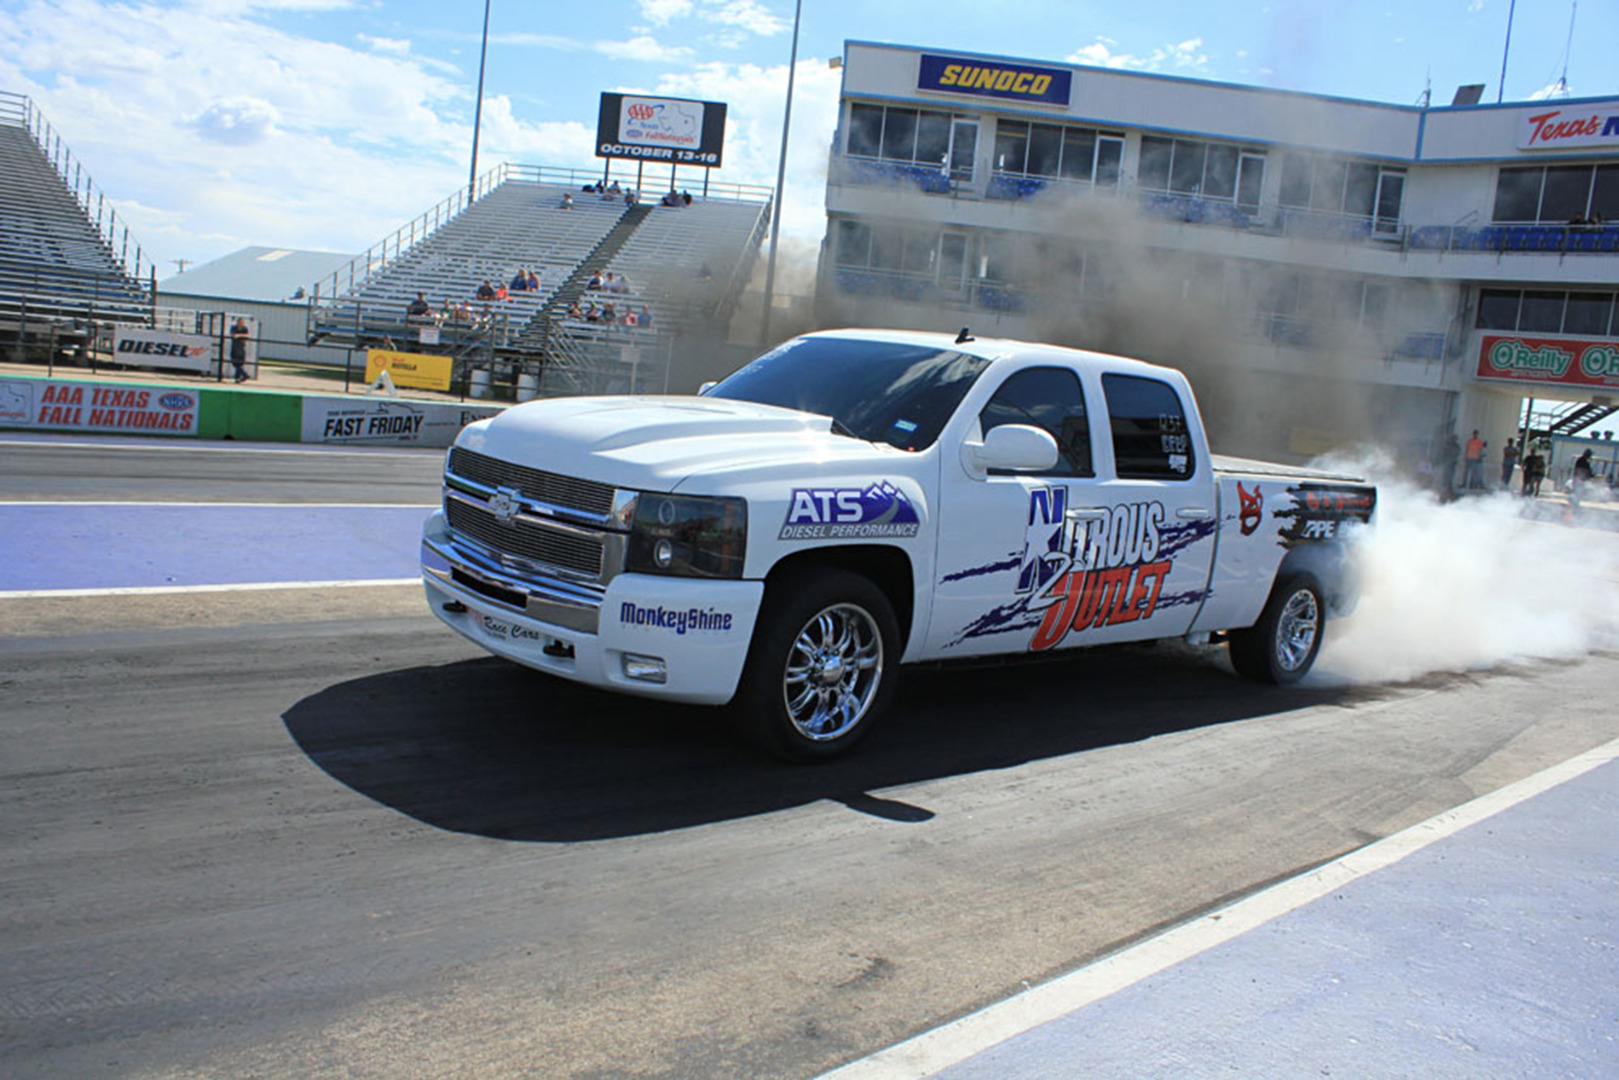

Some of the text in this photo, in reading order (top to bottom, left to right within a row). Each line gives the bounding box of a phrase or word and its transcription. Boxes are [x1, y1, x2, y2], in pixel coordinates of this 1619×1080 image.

[939, 64, 1052, 95] SUNOCO
[1528, 110, 1601, 146] Texas
[600, 143, 673, 158] OCTOBER
[117, 339, 189, 358] DIESEL
[1491, 340, 1571, 374] O'Reilly
[41, 385, 150, 408] AAA TEXAS
[38, 405, 194, 431] FALL NATIONALS
[324, 415, 424, 437] FAST FRIDAY
[789, 490, 863, 523] ATS
[781, 523, 917, 538] DIESEL PERFORMANCE
[620, 602, 732, 635] MonkeyShine
